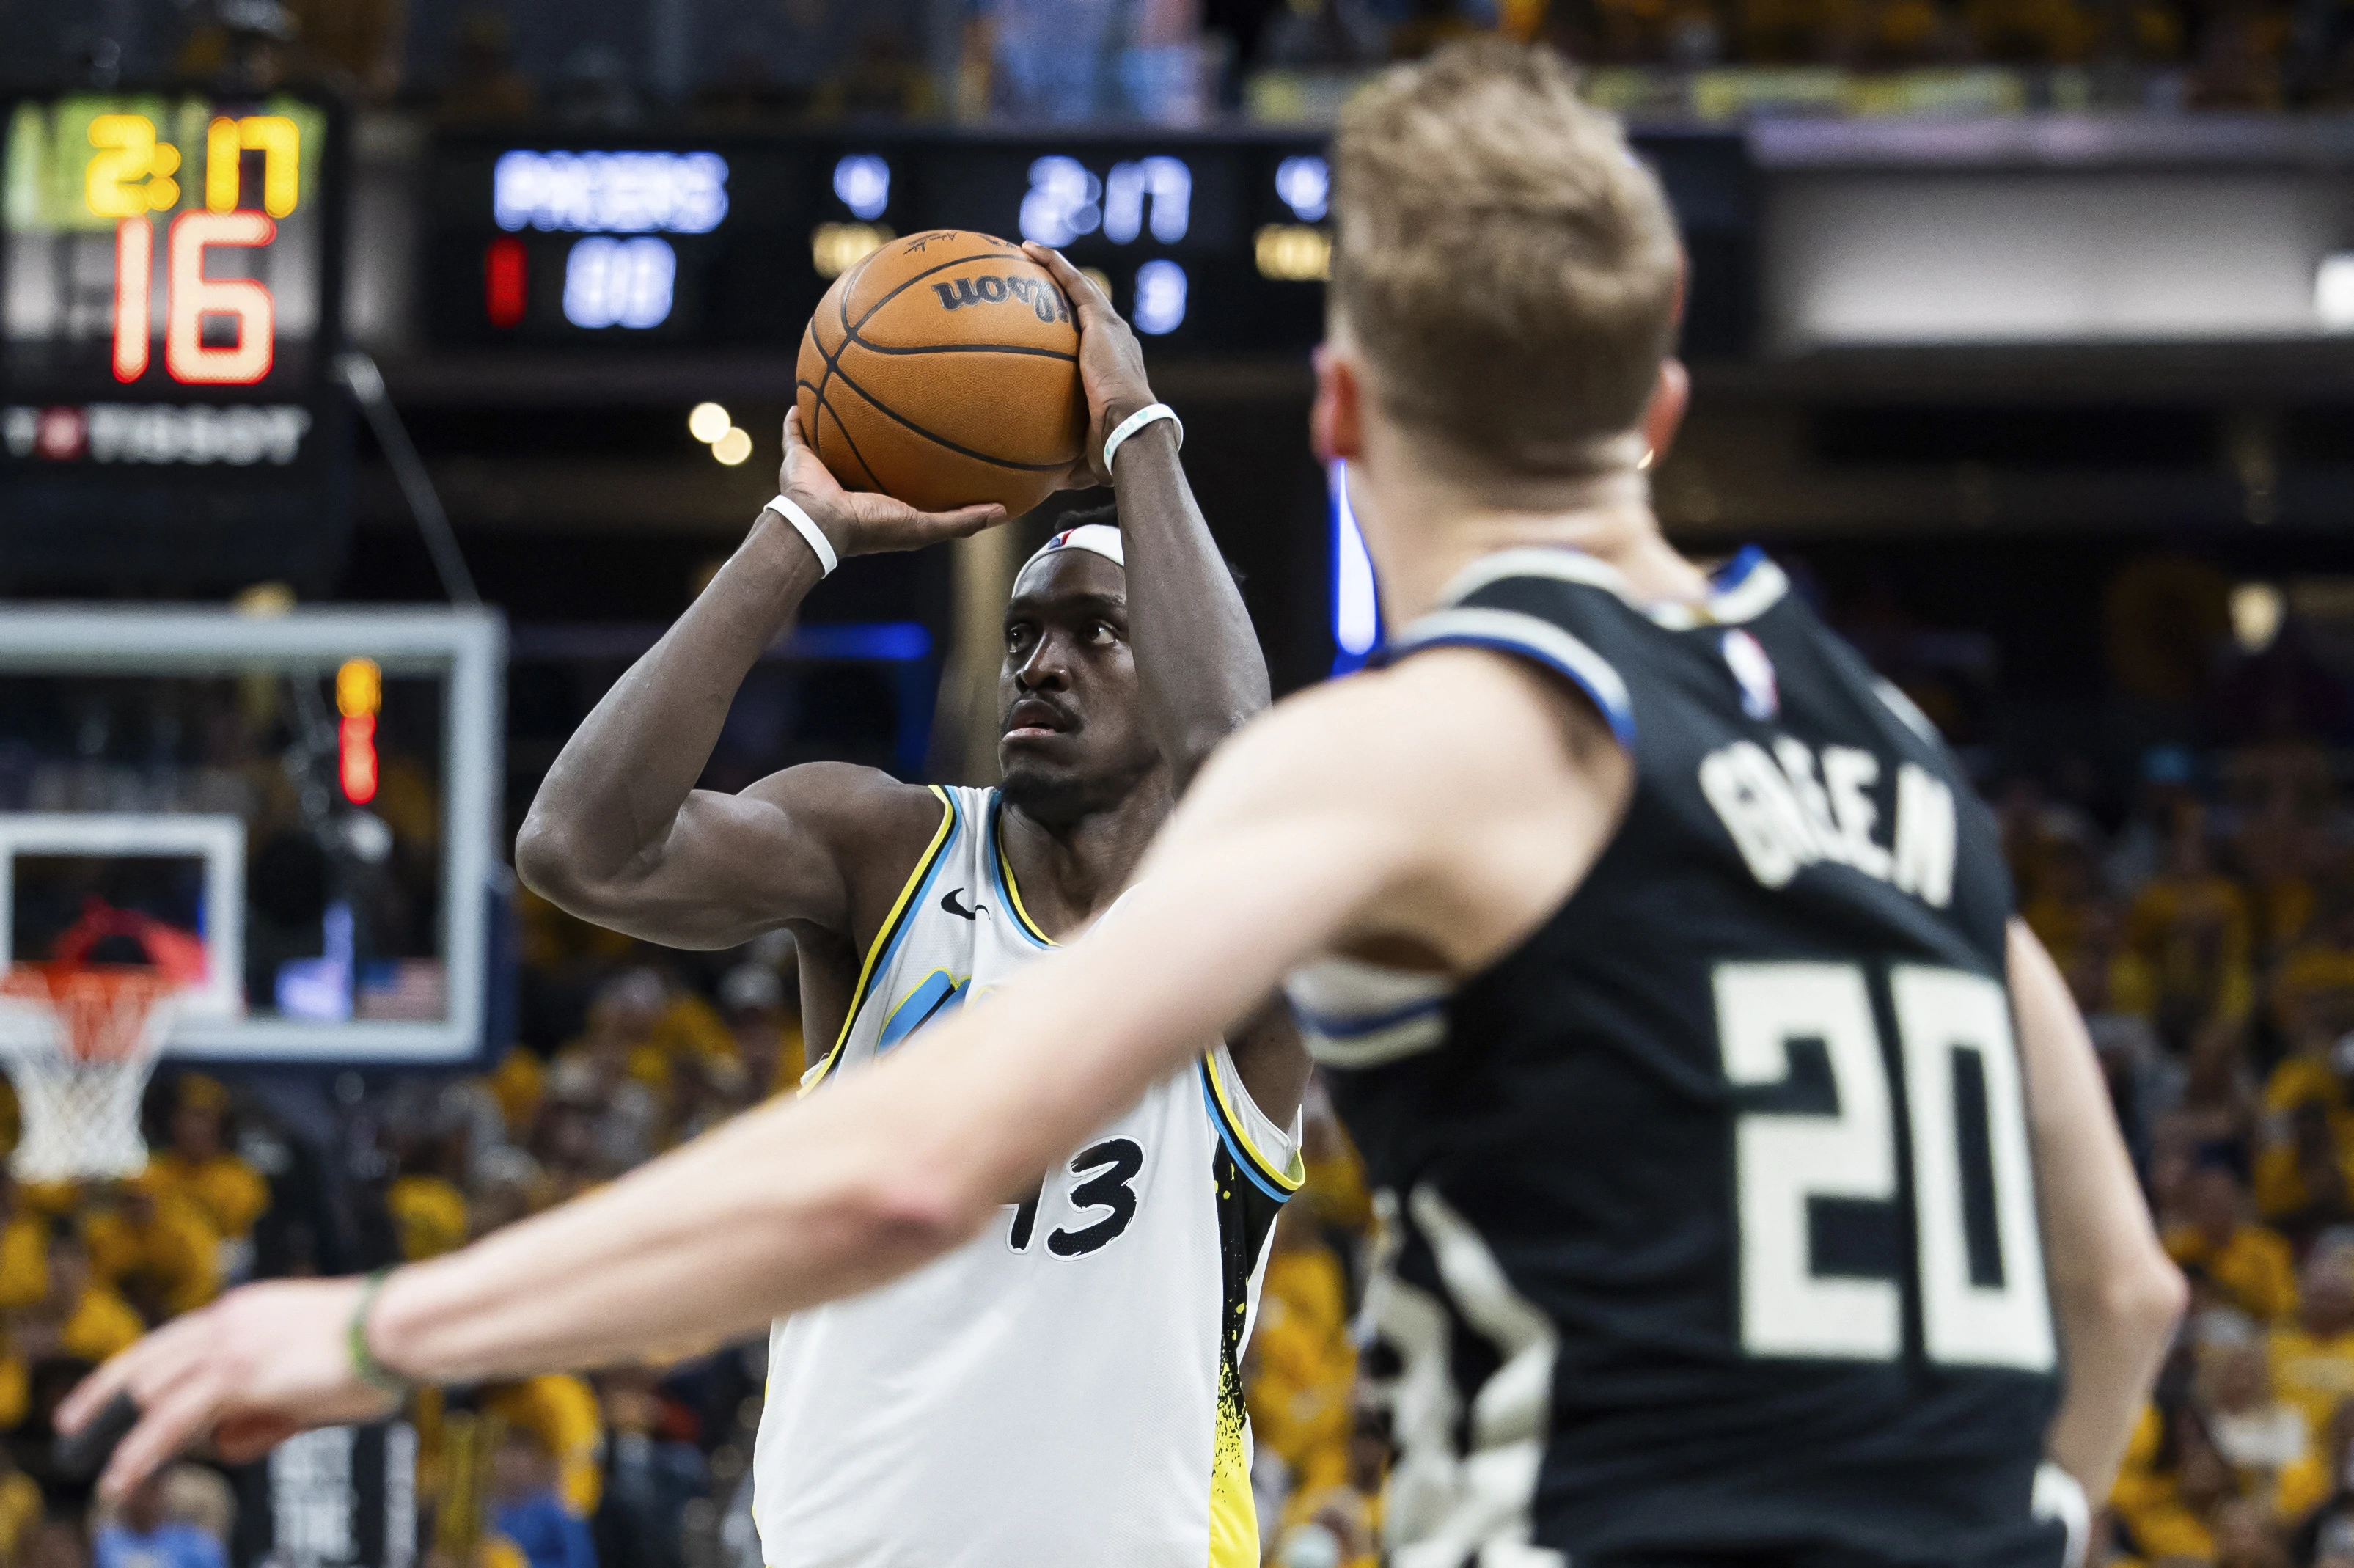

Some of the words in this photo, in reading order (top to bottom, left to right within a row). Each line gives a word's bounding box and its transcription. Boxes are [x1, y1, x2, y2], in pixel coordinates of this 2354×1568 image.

[112, 208, 277, 385] 16
[931, 275, 1079, 327] ilson
[1712, 959, 2057, 1374] 20
